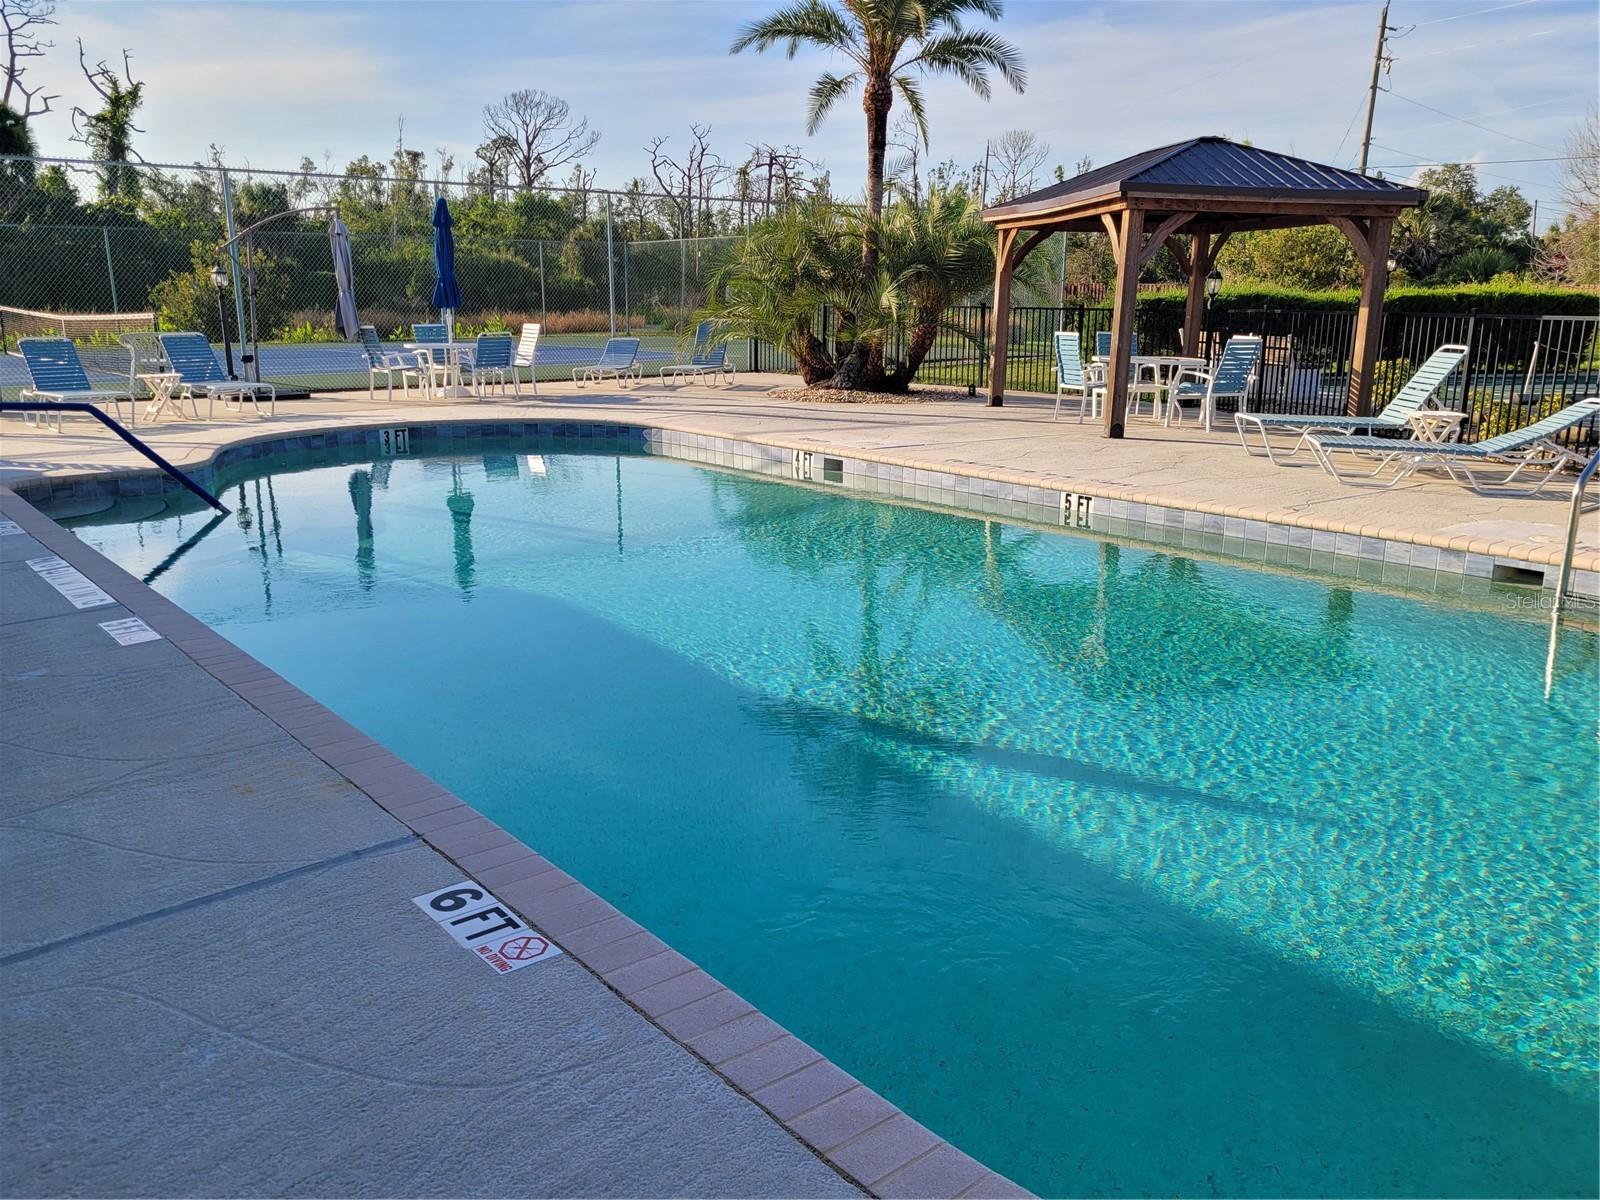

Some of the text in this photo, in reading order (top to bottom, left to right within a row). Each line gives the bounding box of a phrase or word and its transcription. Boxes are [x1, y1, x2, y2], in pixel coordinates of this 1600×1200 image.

[384, 429, 407, 443] 3 FT
[804, 451, 813, 466] FT
[1065, 493, 1093, 513] 5 FT
[430, 888, 521, 941] 6 FT
[477, 945, 513, 972] NO DIVING
